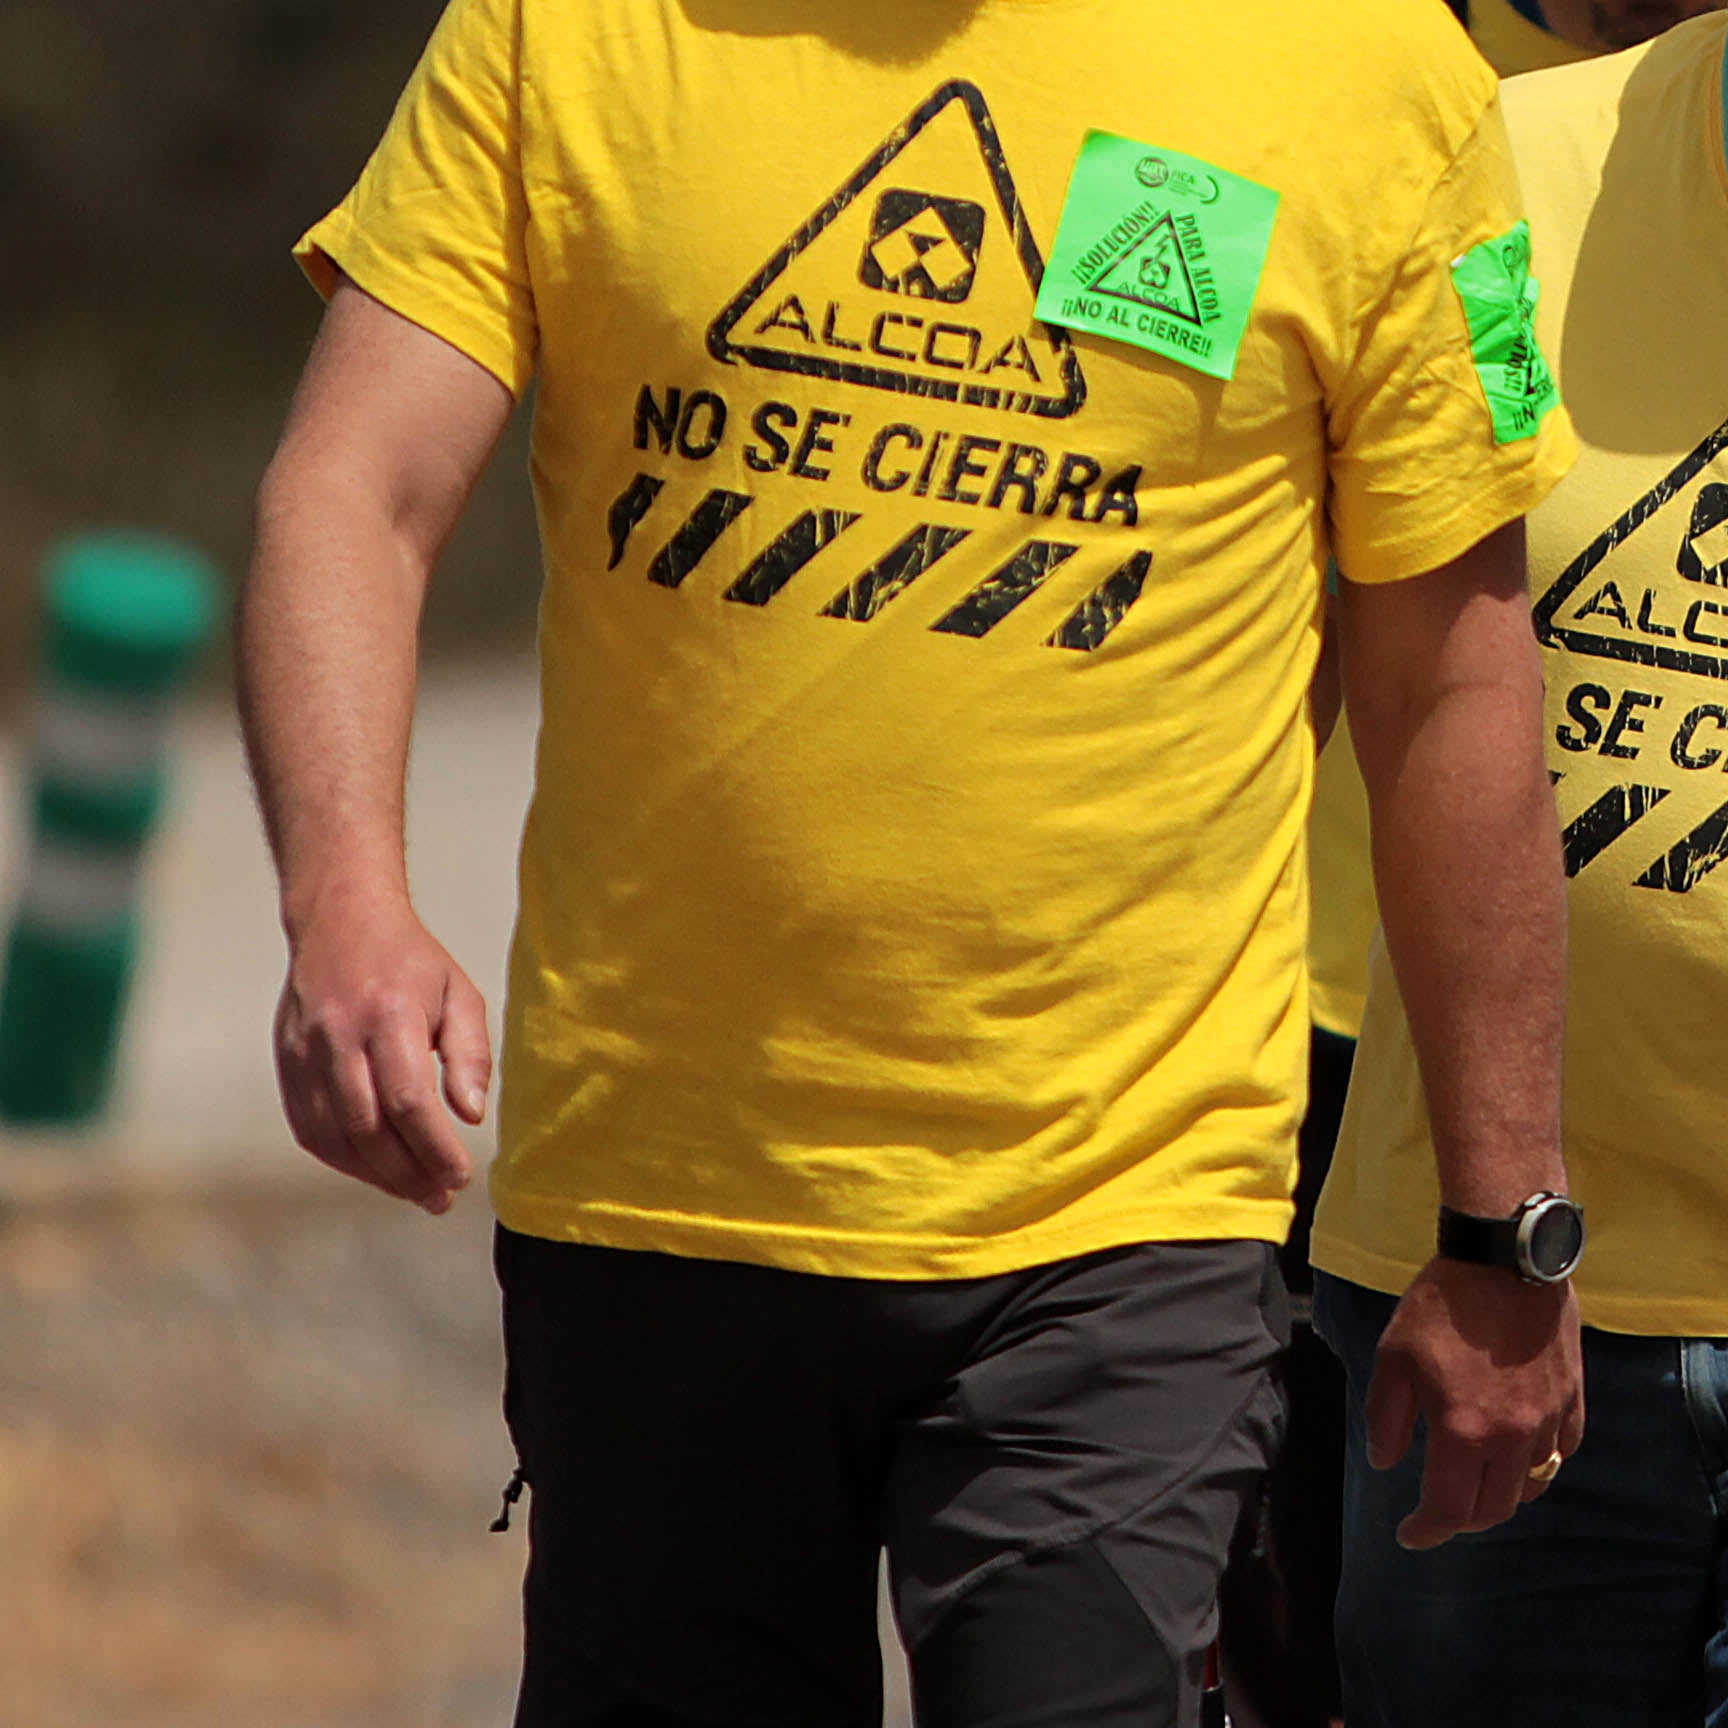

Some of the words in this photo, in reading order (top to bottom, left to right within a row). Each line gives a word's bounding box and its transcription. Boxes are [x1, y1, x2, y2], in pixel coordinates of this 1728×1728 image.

[1116, 281, 1180, 311] ALCOA
[1176, 214, 1205, 260] PARA
[1198, 267, 1222, 322] ALCOA
[755, 294, 1041, 381] ALCOA
[1106, 307, 1130, 328] AL
[634, 383, 726, 459] NO
[744, 400, 851, 480] SE
[861, 422, 1141, 525] CIERRA
[1557, 683, 1664, 758] SE
